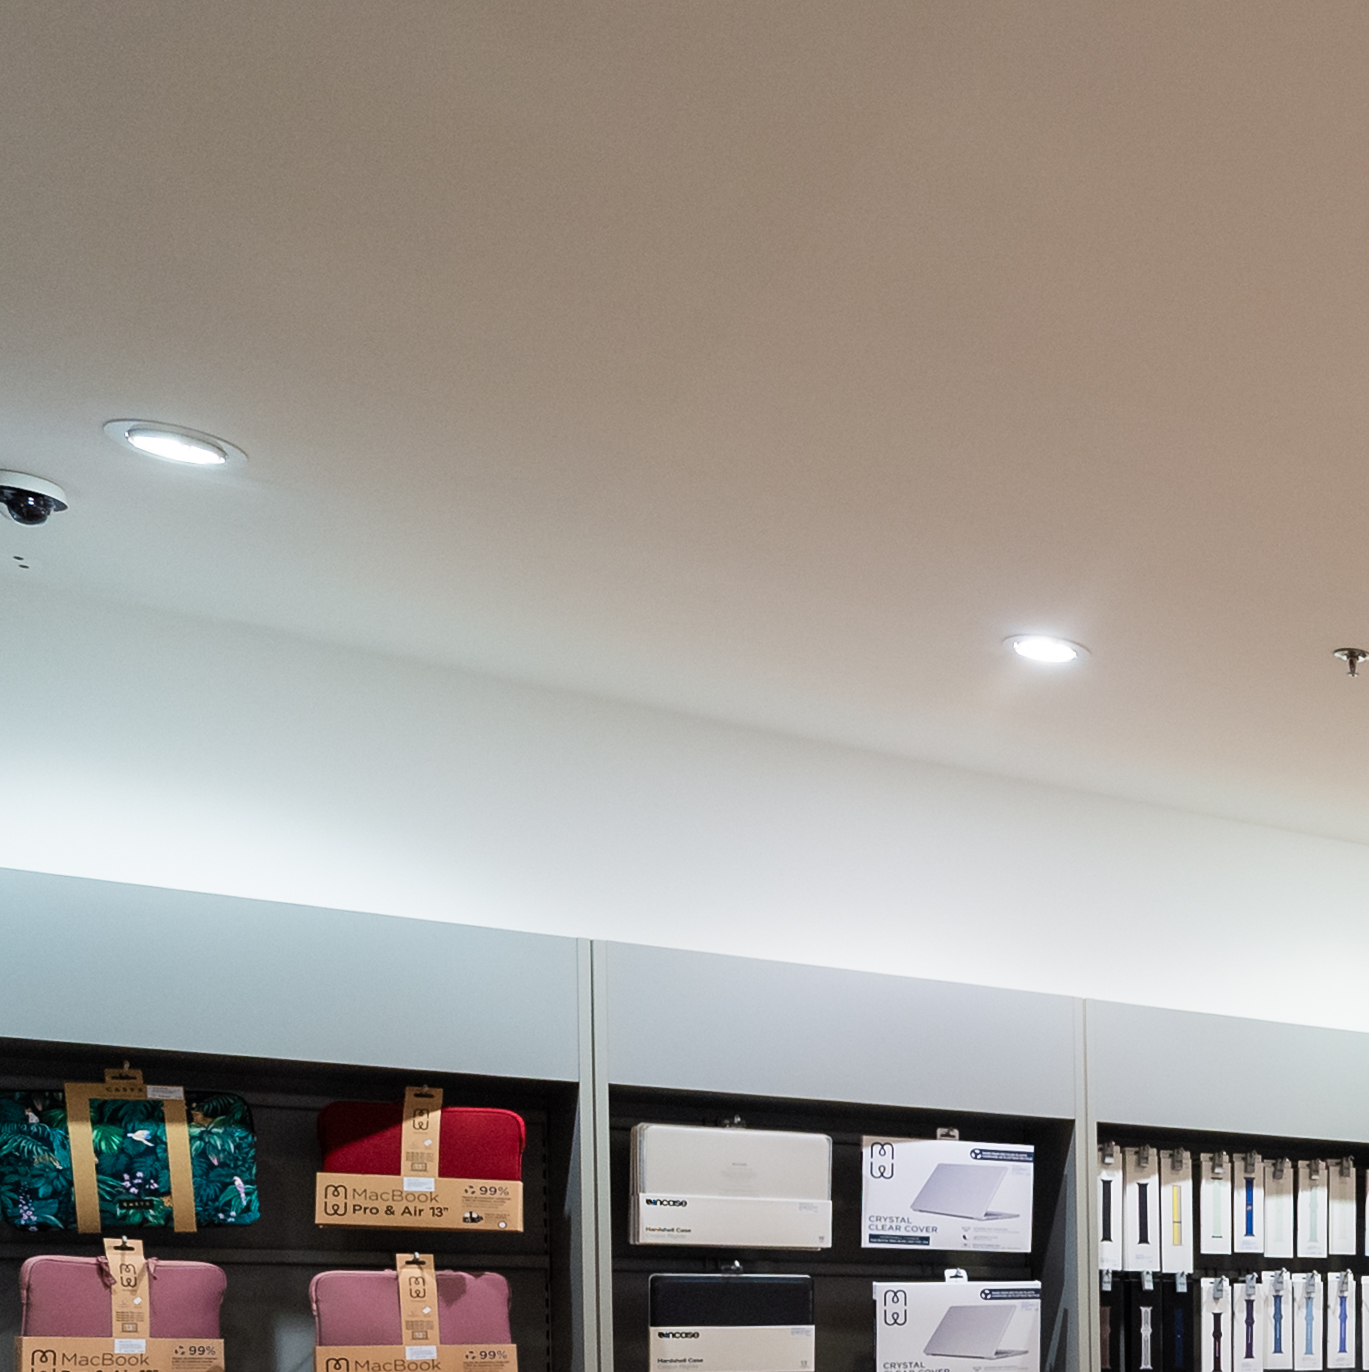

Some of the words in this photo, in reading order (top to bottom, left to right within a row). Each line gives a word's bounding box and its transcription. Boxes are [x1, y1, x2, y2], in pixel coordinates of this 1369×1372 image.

[352, 1188, 439, 1204] MacBook
[479, 1186, 510, 1196] 99%
[352, 1204, 379, 1216] Pro
[384, 1205, 396, 1216] &
[401, 1206, 424, 1217] Air
[868, 1215, 912, 1224] CRYSTAL
[868, 1224, 902, 1232] CLEAR
[904, 1225, 938, 1233] COVER
[188, 1346, 216, 1356] 99%
[479, 1350, 508, 1360] 99%
[61, 1353, 150, 1366] MacBook
[354, 1359, 441, 1372] MacBook
[883, 1362, 925, 1370] CRYSTAL
